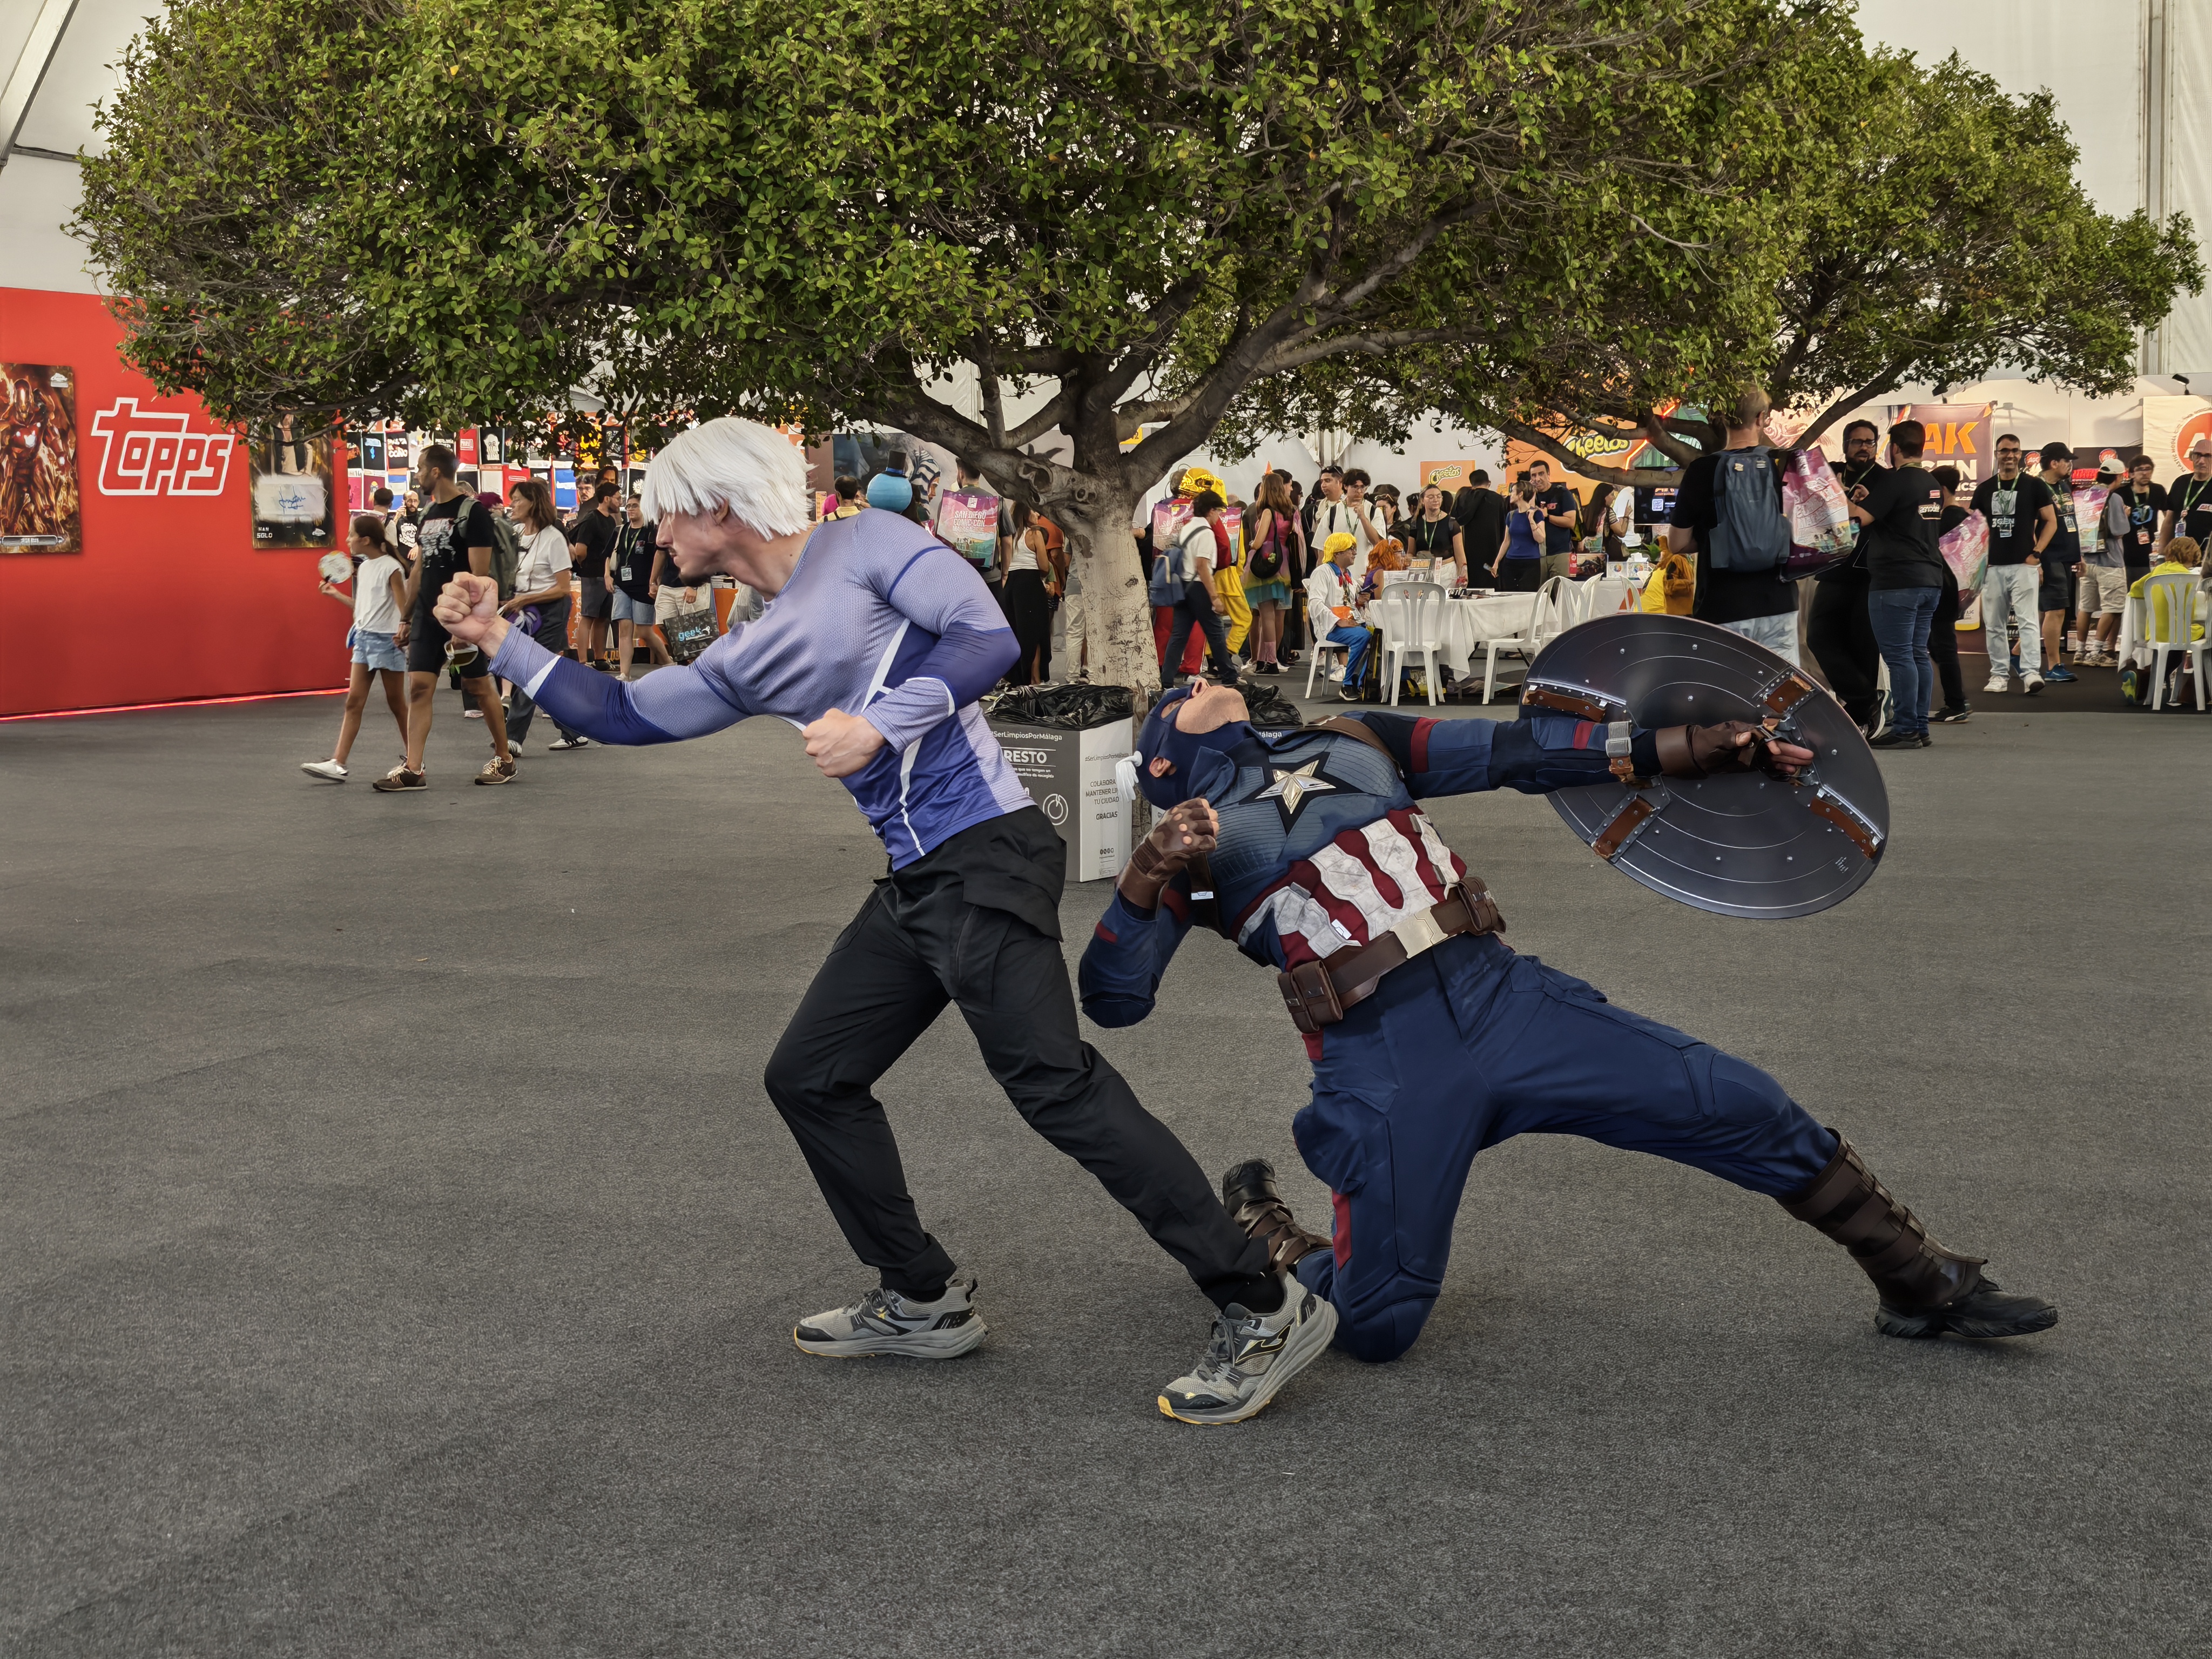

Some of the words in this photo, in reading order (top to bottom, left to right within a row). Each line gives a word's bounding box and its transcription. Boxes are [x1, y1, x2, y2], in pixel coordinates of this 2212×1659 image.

[1923, 421, 1979, 454] AK
[1430, 466, 1460, 484] Cheetos
[955, 510, 967, 518] SAN
[968, 511, 986, 520] DIEGO
[1003, 750, 1047, 764] RESTO
[1090, 779, 1116, 787] COLABORA
[1085, 787, 1111, 797] MANTENER
[1101, 796, 1120, 805] CIUDAD
[1096, 811, 1118, 820] GRACIAS
